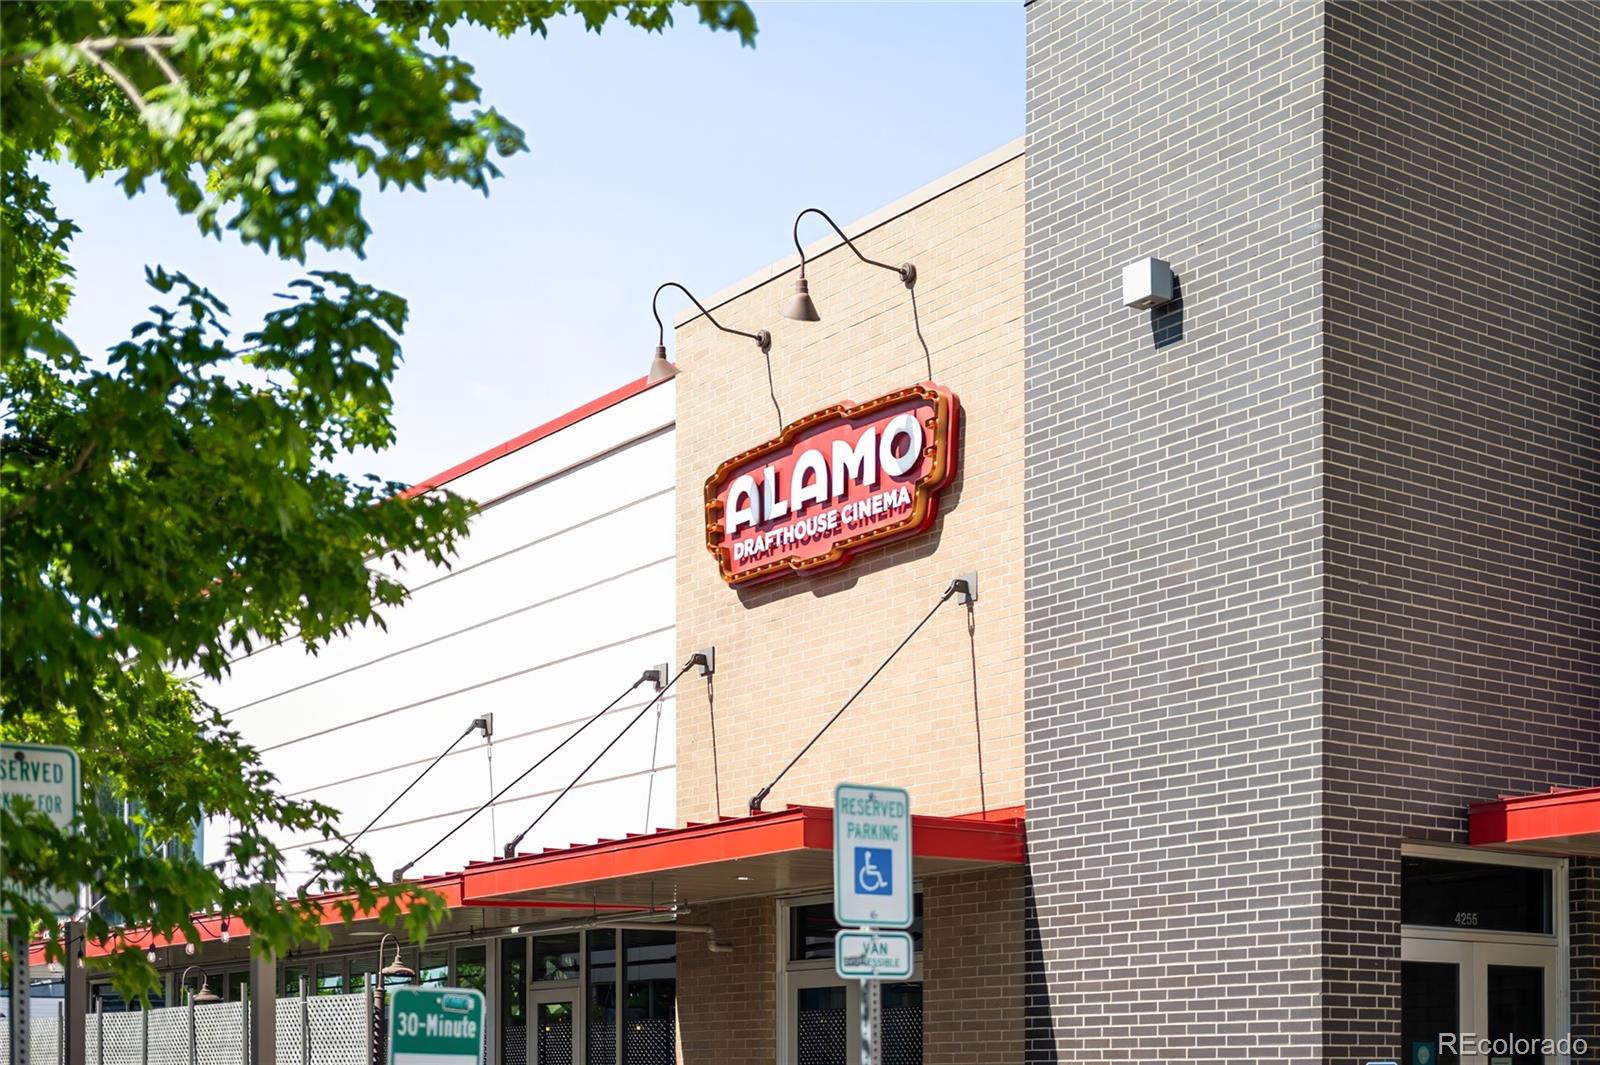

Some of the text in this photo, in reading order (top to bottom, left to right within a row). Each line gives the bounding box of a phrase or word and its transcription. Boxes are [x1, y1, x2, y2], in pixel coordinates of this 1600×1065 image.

[725, 413, 923, 534] ALAMO
[733, 485, 911, 561] DRAFTHOUSE CINEMA
[38, 794, 63, 815] FOR
[841, 797, 904, 818] RESERVED
[847, 821, 899, 842] PARKING
[1455, 911, 1479, 926] 4255
[862, 941, 888, 955] VAN
[844, 957, 901, 969] ESSIBLE
[397, 1011, 478, 1039] 30-Minute
